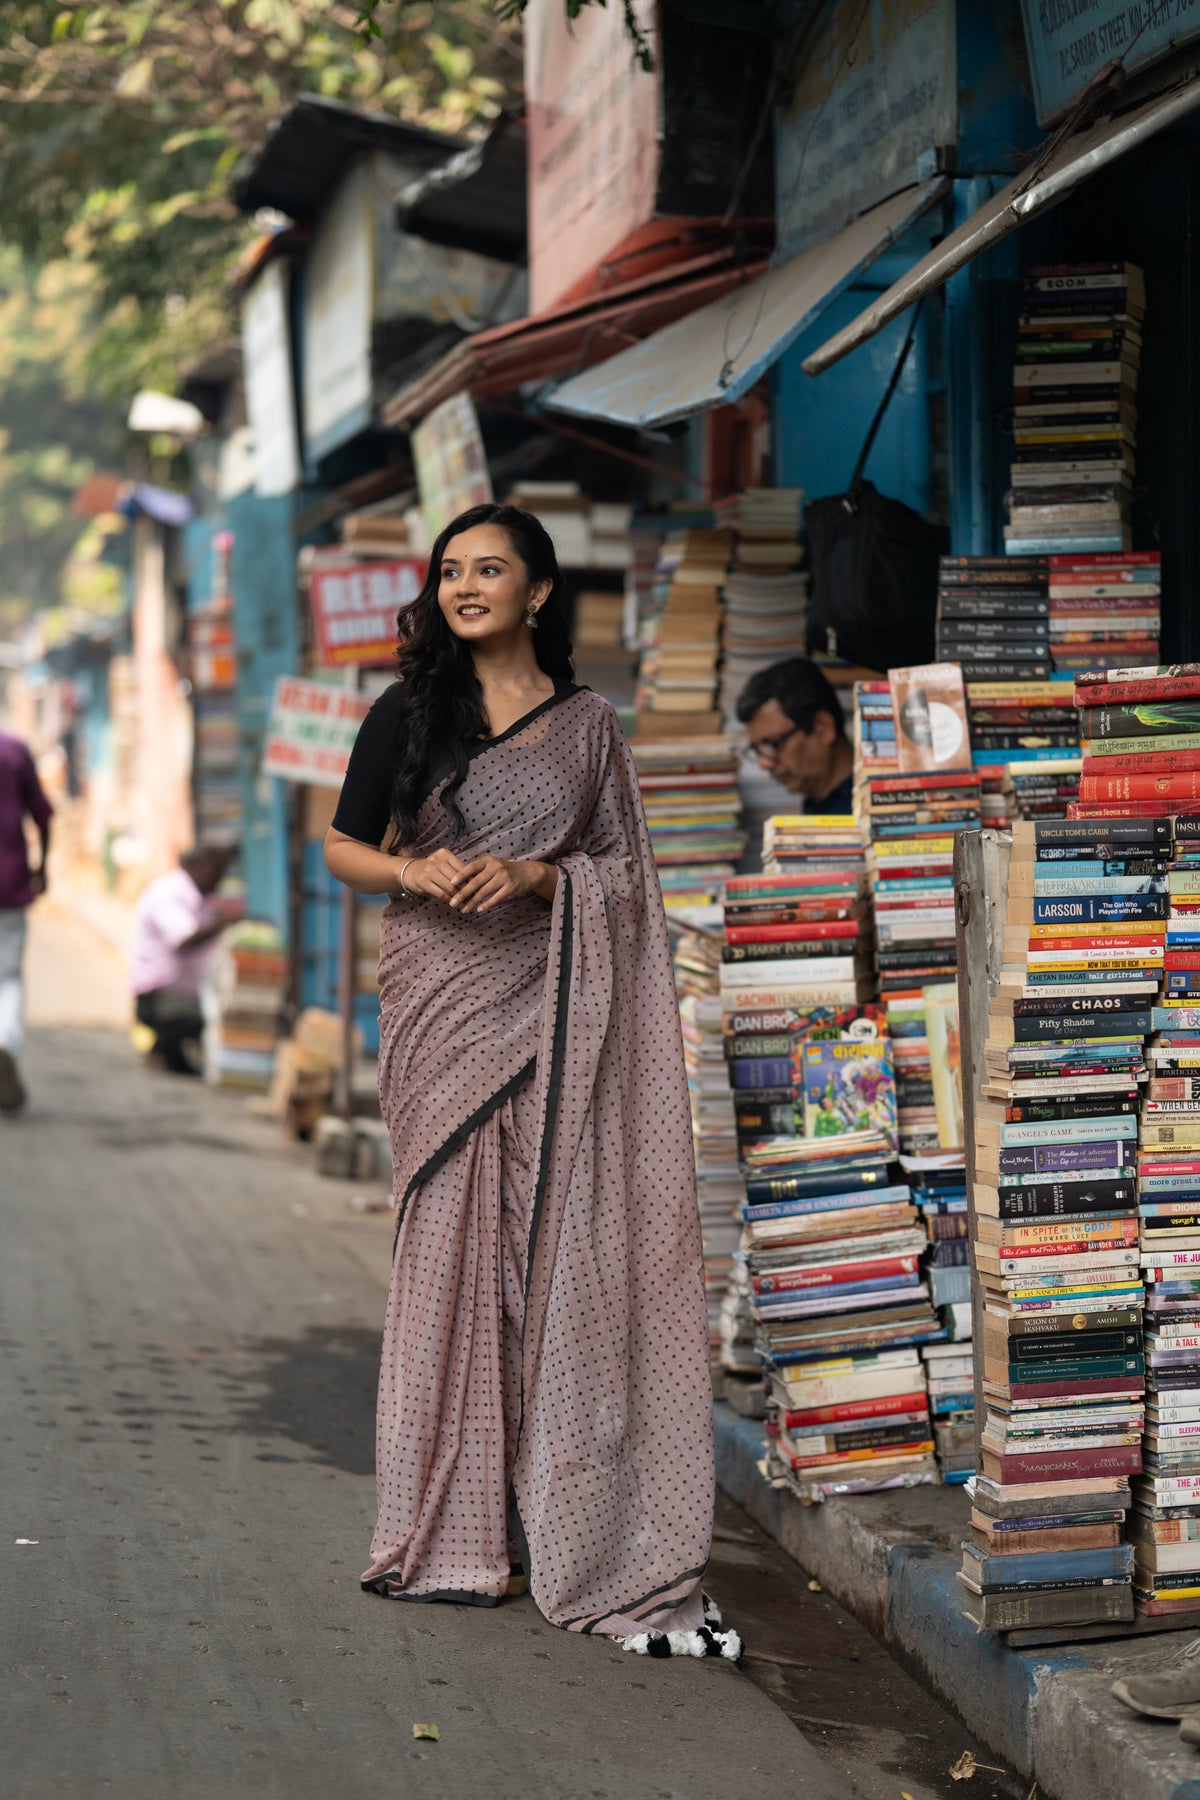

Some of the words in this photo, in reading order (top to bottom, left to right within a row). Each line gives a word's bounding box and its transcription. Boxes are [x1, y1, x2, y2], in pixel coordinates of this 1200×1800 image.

[1040, 829, 1063, 837] UNCLE
[1044, 880, 1082, 892] JEFFREY
[1082, 880, 1117, 890] ARCHER
[1038, 904, 1082, 918] LARSSON
[748, 943, 781, 956] HARRY
[785, 942, 824, 953] POTTER
[1029, 973, 1056, 981] CHETAN
[1107, 971, 1143, 979] girlfriend
[1045, 987, 1067, 995] RODDY
[736, 994, 776, 1007] SACHIN
[1072, 999, 1122, 1010] CHAOS
[734, 1016, 761, 1031] DAN
[763, 1014, 788, 1030] BRO
[1038, 1020, 1060, 1029] Fifty
[1063, 1018, 1095, 1028] Shades
[735, 1040, 761, 1054] DAN
[763, 1040, 788, 1053] BRO
[1161, 1101, 1184, 1110] WHEN
[1016, 1130, 1048, 1138] ANGEL'S
[1172, 1178, 1192, 1186] great
[747, 1207, 781, 1219] HAMLYN
[783, 1203, 812, 1214] JUNIOR
[1020, 1228, 1029, 1237] IN
[1032, 1226, 1060, 1236] SPITE
[1084, 1222, 1114, 1233] GODS
[1088, 1240, 1112, 1250] RAVINDER
[1114, 1240, 1130, 1248] SINGH
[1003, 1248, 1014, 1256] This
[1015, 1247, 1028, 1256] Love
[1030, 1246, 1042, 1254] That
[1174, 1254, 1188, 1264] THE
[1096, 1316, 1118, 1324] AMISH
[1024, 1324, 1060, 1333] IKSHVAKU
[1182, 1338, 1198, 1346] TALE
[850, 1406, 874, 1416] THIRD
[875, 1402, 902, 1412] SECRET
[1094, 1460, 1125, 1469] CANAVAN
[1177, 1478, 1191, 1488] THE
